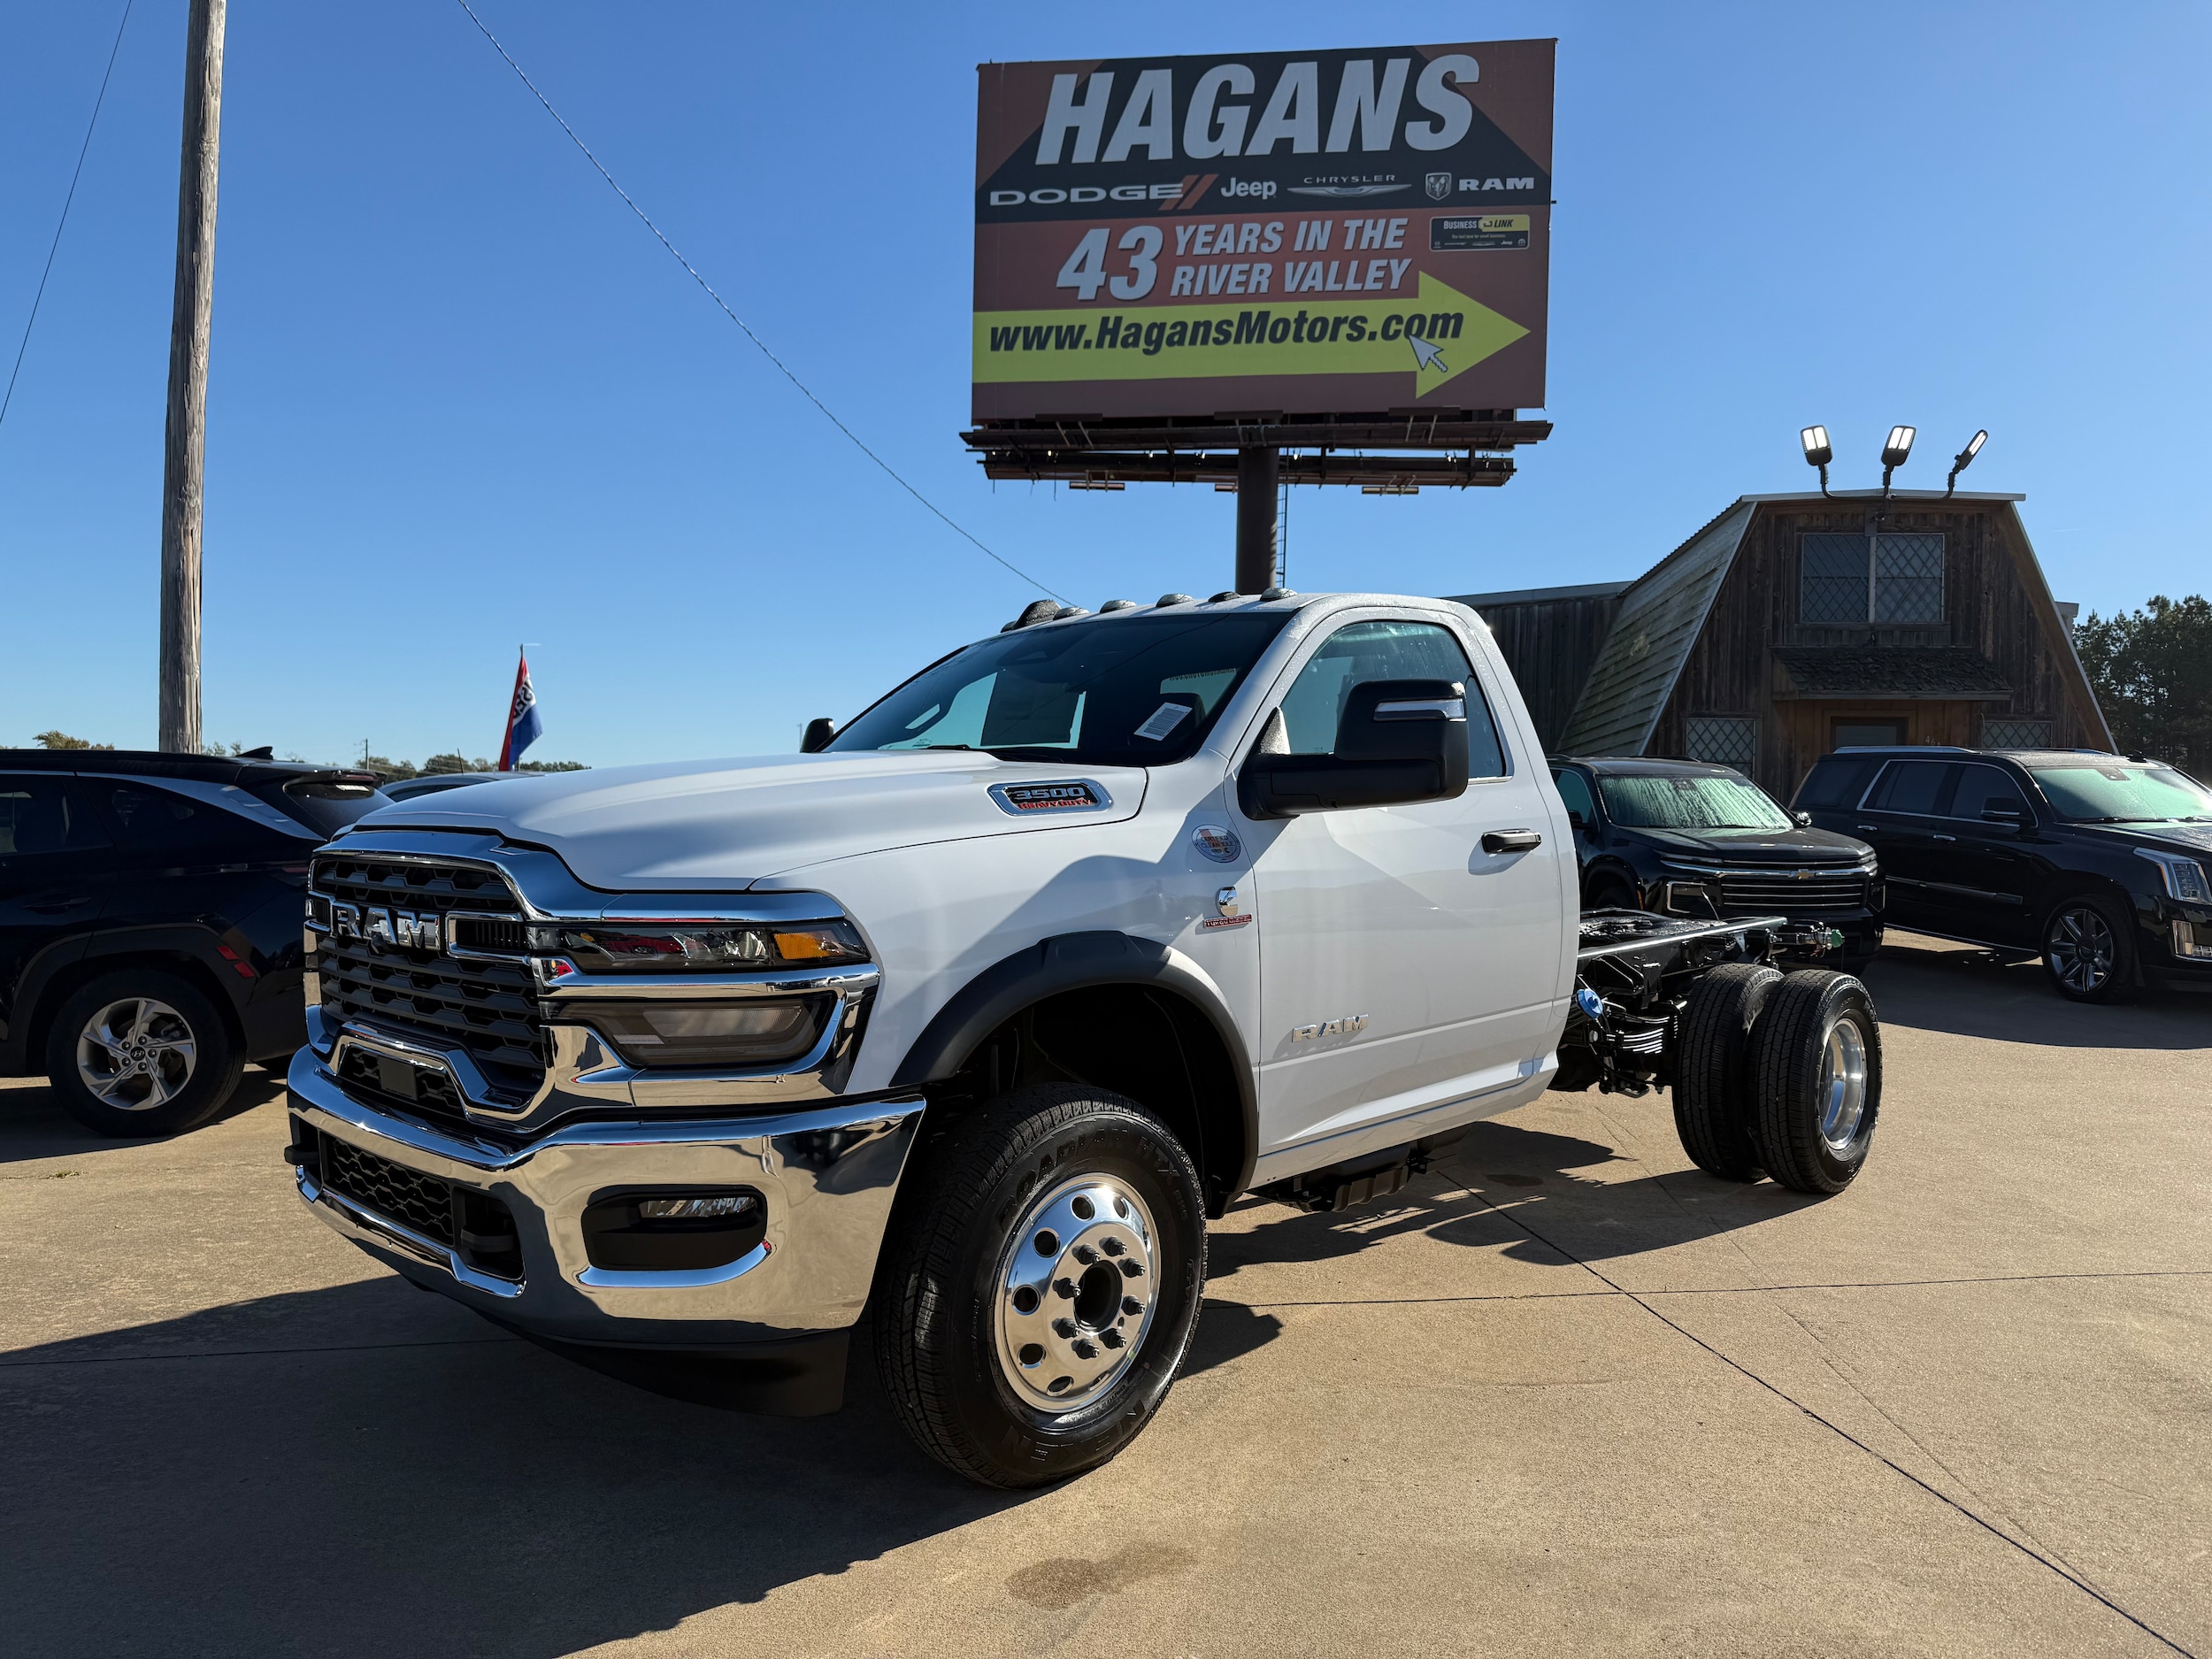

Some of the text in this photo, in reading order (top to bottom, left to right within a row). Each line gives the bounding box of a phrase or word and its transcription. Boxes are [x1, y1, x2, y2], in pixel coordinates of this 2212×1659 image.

[1035, 54, 1480, 165] HAGANS
[1220, 177, 1277, 200] Jeep
[1302, 174, 1395, 184] CHRYSLER
[1458, 177, 1535, 192] RAM
[990, 183, 1184, 206] DODGE
[1443, 219, 1514, 229] BUSINESS LINK
[1174, 218, 1409, 257] YEARS IN THE
[1056, 225, 1164, 301] 43
[1170, 257, 1413, 297] RIVER VALLEY
[989, 310, 1463, 355] www.HagansMotors.com
[1012, 787, 1086, 800] 3500
[1018, 798, 1090, 809] HEAVY DUTY
[330, 901, 440, 950] RAM
[1292, 1014, 1368, 1042] RAM
